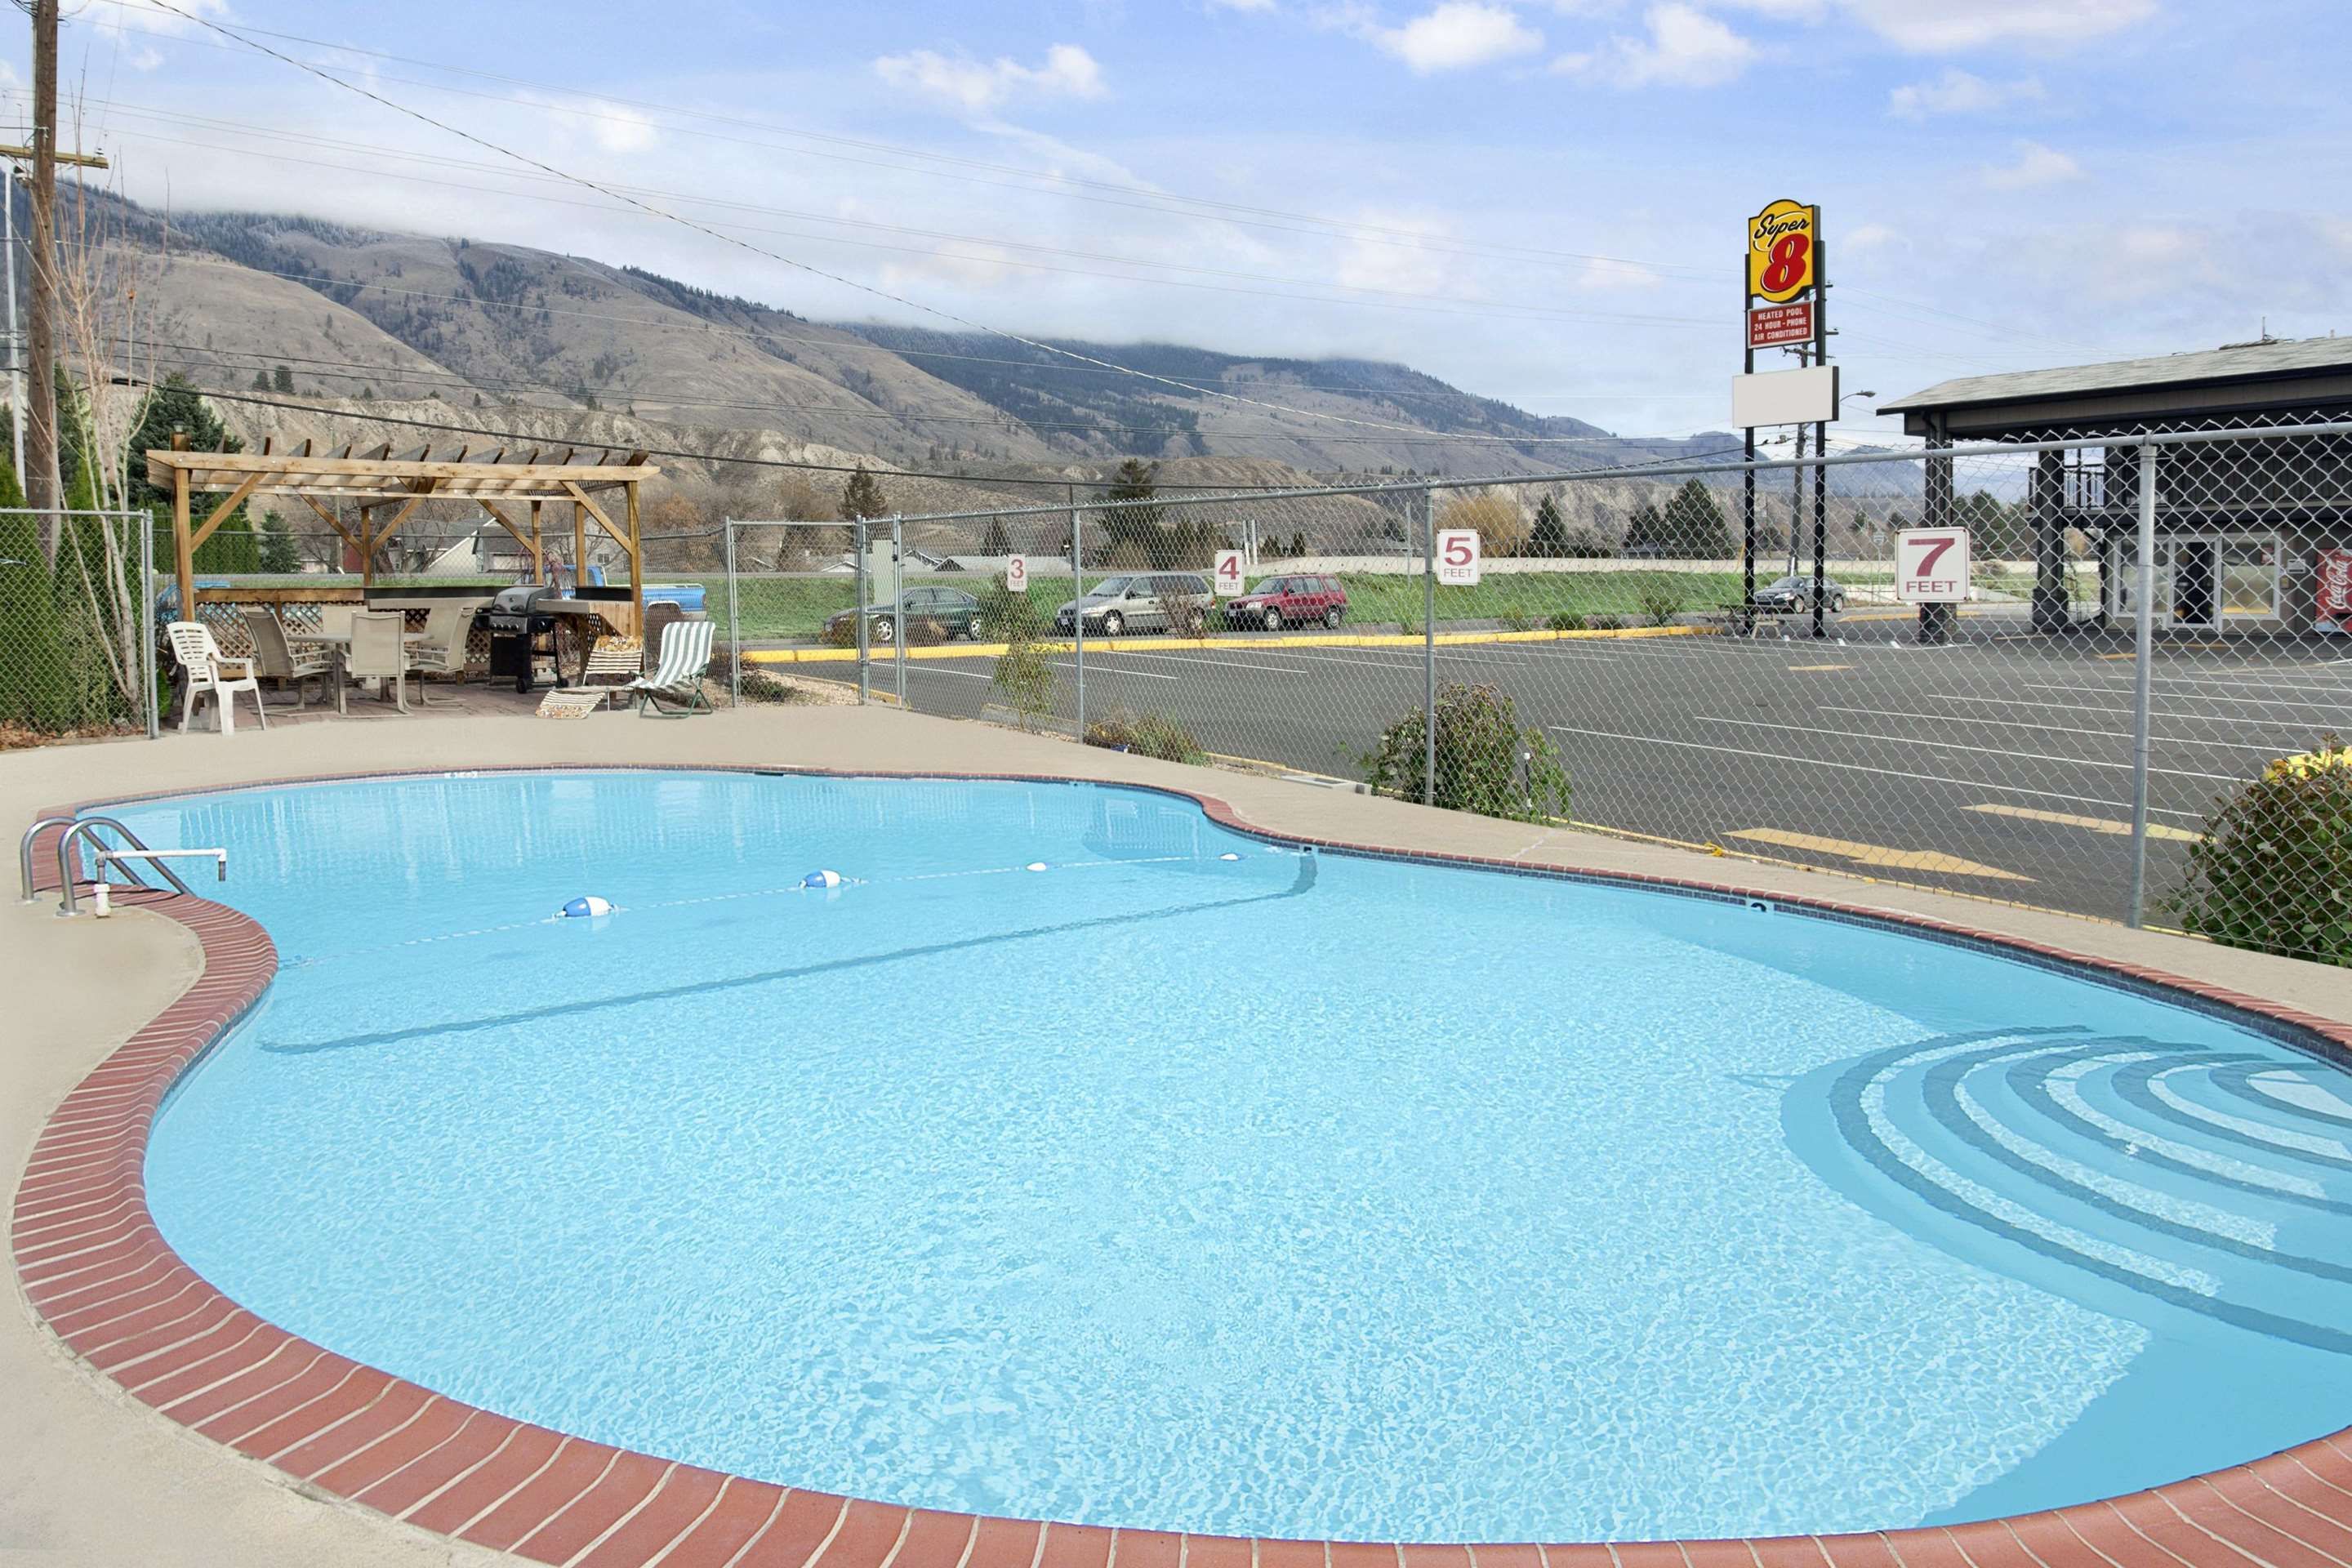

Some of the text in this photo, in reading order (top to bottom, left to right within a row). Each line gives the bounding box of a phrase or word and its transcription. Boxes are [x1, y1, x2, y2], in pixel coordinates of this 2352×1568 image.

[1754, 213, 1811, 247] Super
[1761, 233, 1810, 293] 8
[1757, 307, 1804, 321] HEATED POOL
[1754, 323, 1763, 332] 24
[1765, 320, 1782, 330] HOUR
[1786, 317, 1807, 327] PHONE
[1753, 327, 1808, 341] AIR CONDITIONED
[1445, 537, 1473, 566] 5
[1908, 537, 1955, 577] 7
[1010, 559, 1024, 579] 3
[1218, 555, 1240, 580] 4
[1444, 568, 1473, 578] FEET
[1218, 581, 1239, 590] FEET
[1906, 581, 1958, 593] FEET
